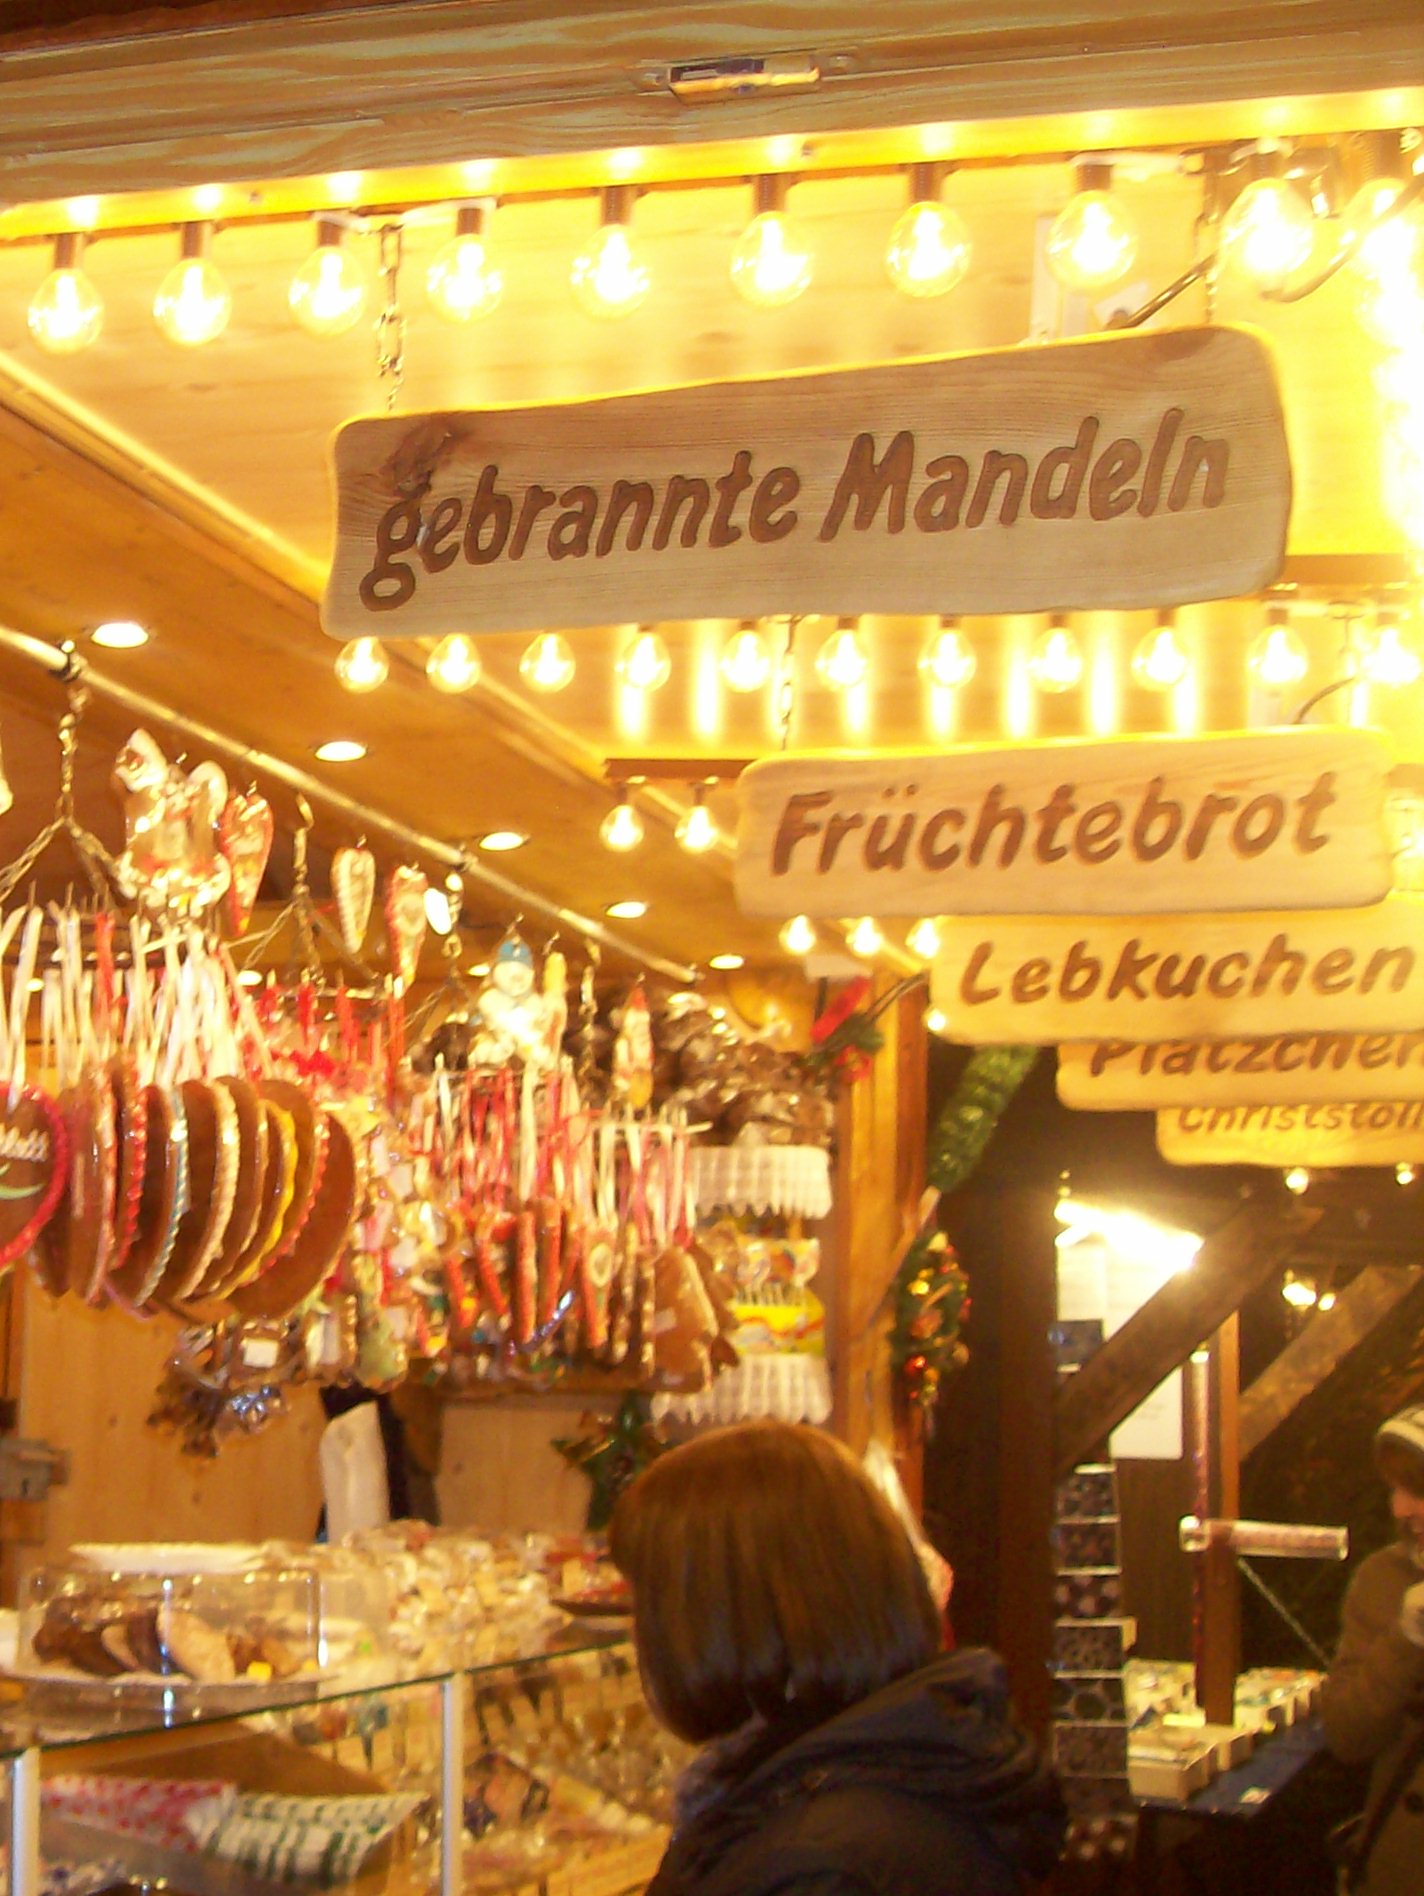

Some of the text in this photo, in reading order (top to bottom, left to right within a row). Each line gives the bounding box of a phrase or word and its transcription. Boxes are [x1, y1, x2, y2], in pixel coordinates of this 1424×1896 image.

[359, 407, 1230, 612] gebrannte Mandeln
[769, 770, 1337, 876] Früchtebrot
[959, 932, 1416, 1006] Lebkuchen
